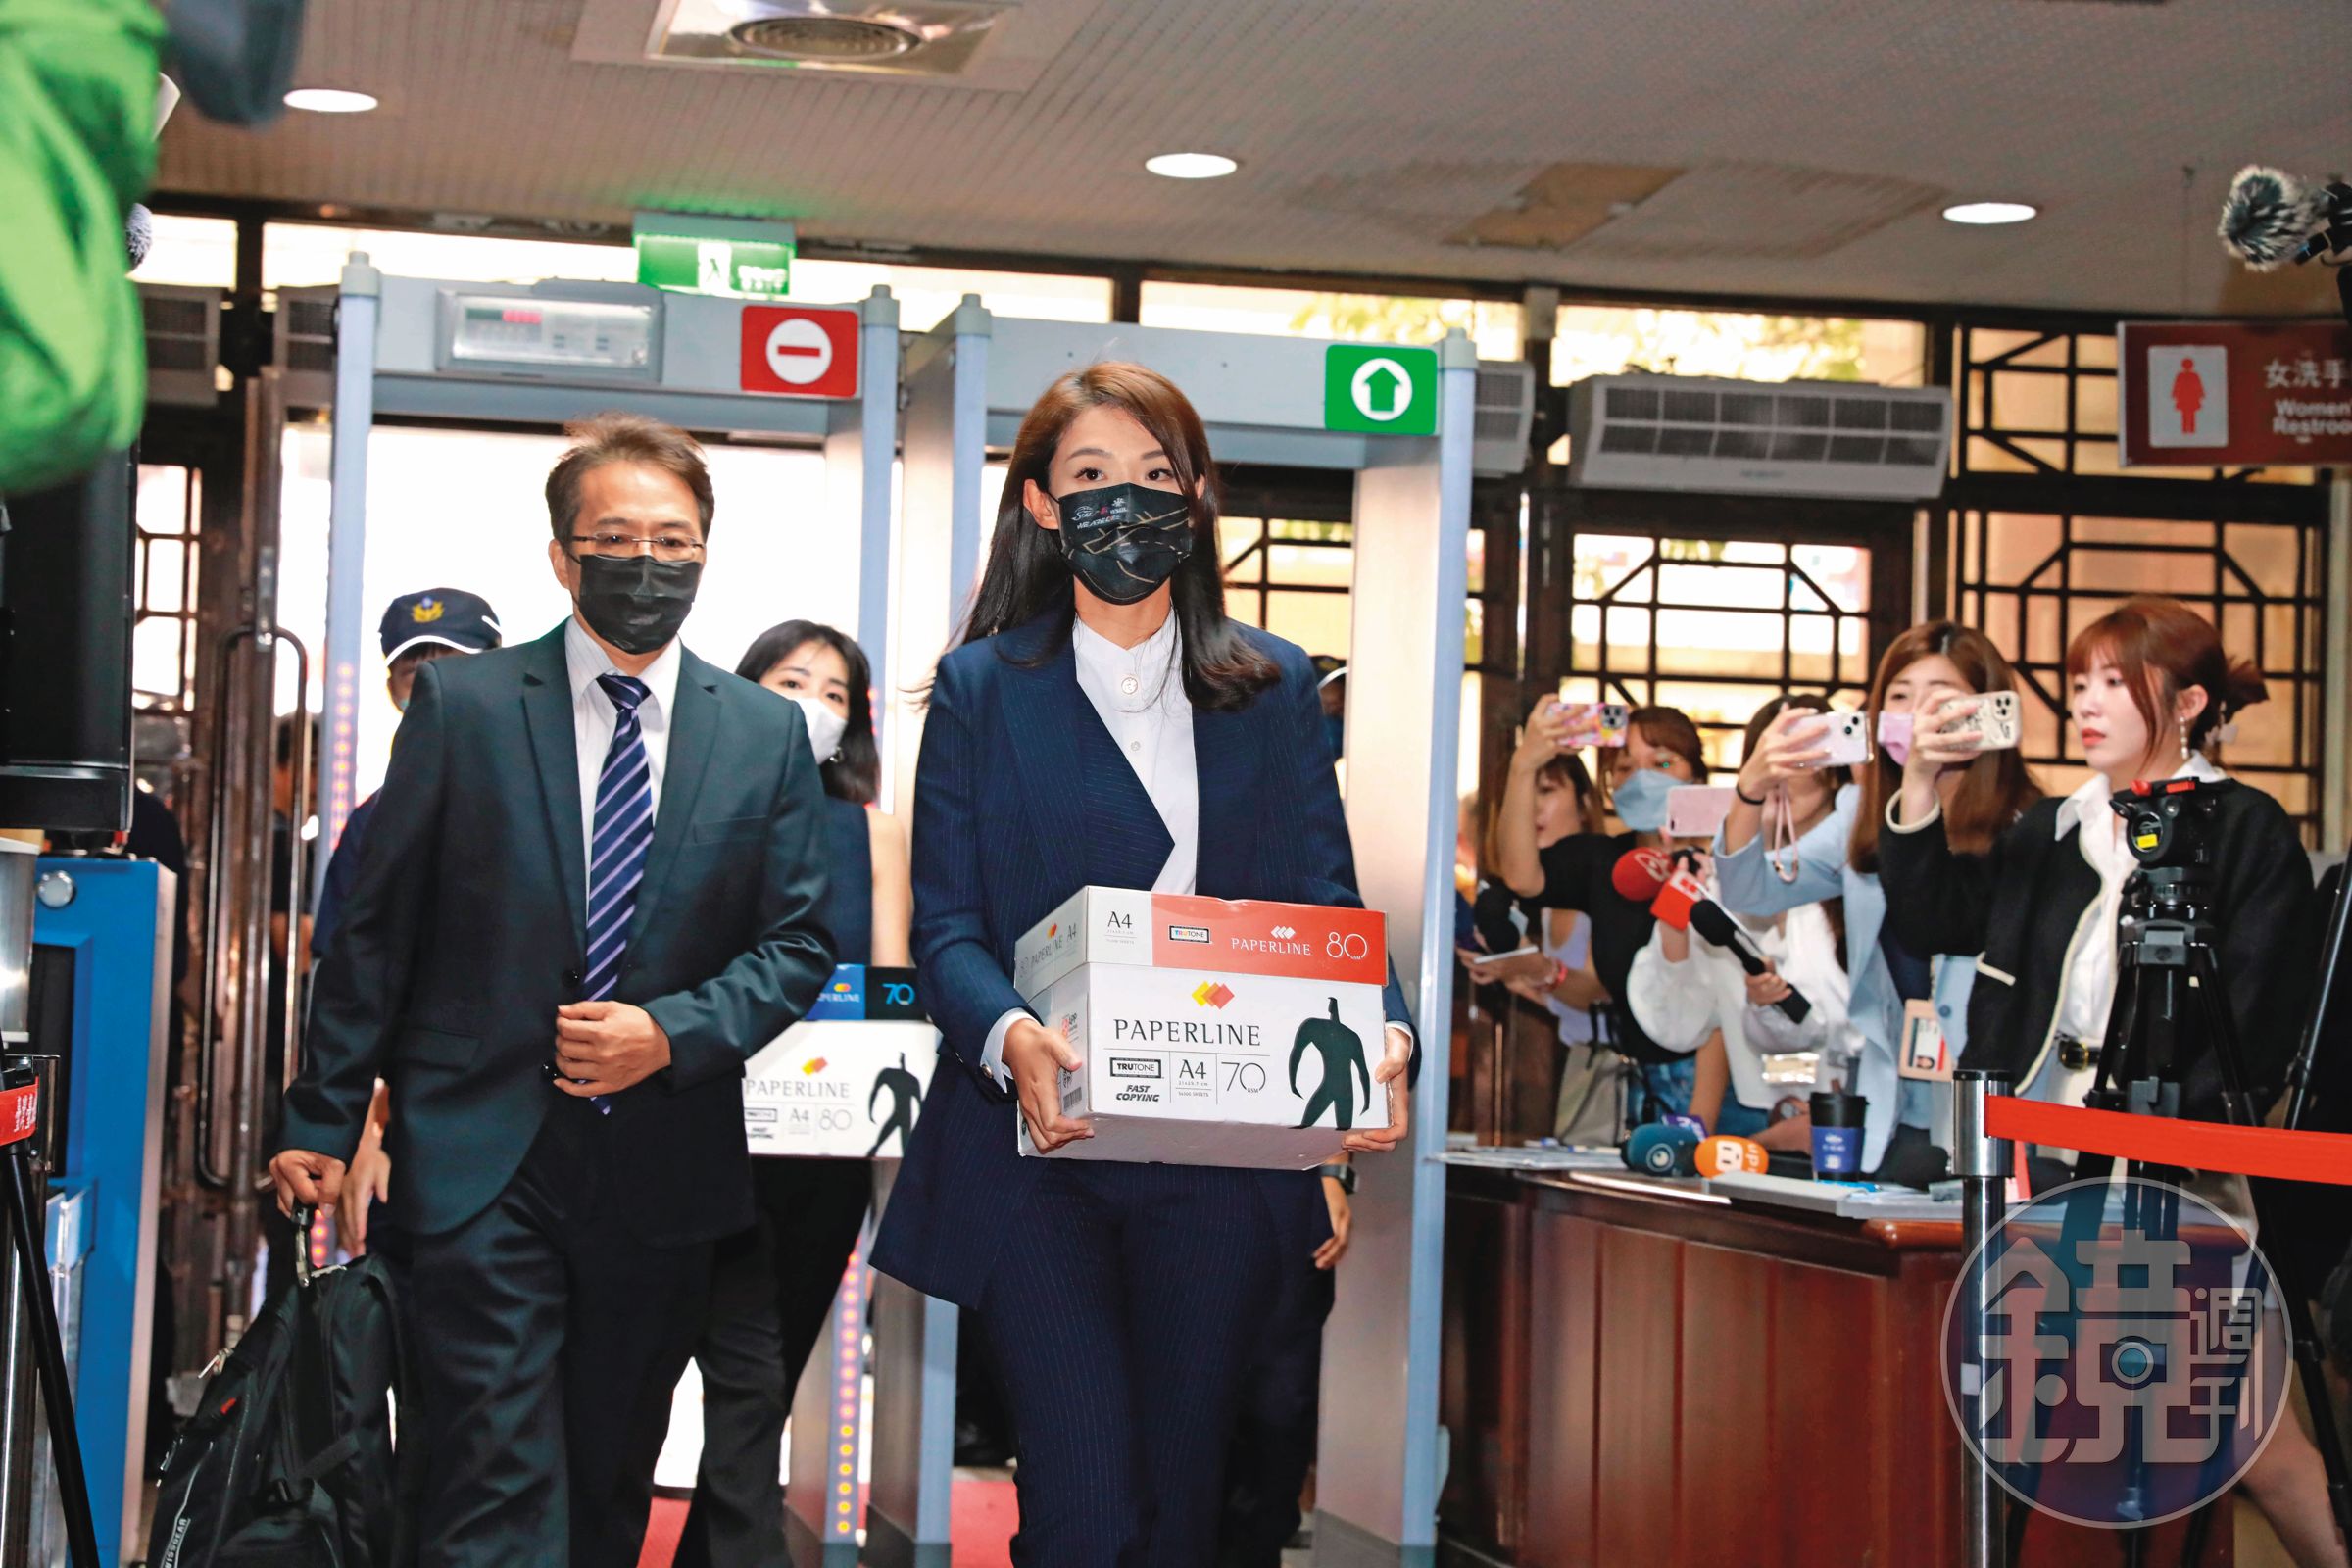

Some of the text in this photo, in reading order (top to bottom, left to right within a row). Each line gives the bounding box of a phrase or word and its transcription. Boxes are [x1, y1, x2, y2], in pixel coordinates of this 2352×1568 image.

[1107, 911, 1133, 929] A4
[1231, 937, 1312, 956] PAPERLINE
[1326, 931, 1368, 958] 80
[816, 993, 860, 1002] PERLINE
[882, 983, 915, 1005] 70
[1113, 1018, 1261, 1047] PAPERLINE
[1117, 1062, 1155, 1072] TRUTONE
[1179, 1059, 1207, 1080] A4
[1221, 1061, 1266, 1092] 70
[746, 1079, 851, 1098] PAPERLINE
[1115, 1092, 1160, 1102] COPYING
[1125, 1084, 1151, 1093] FAST
[790, 1107, 810, 1122] A4
[819, 1108, 853, 1131] 80
